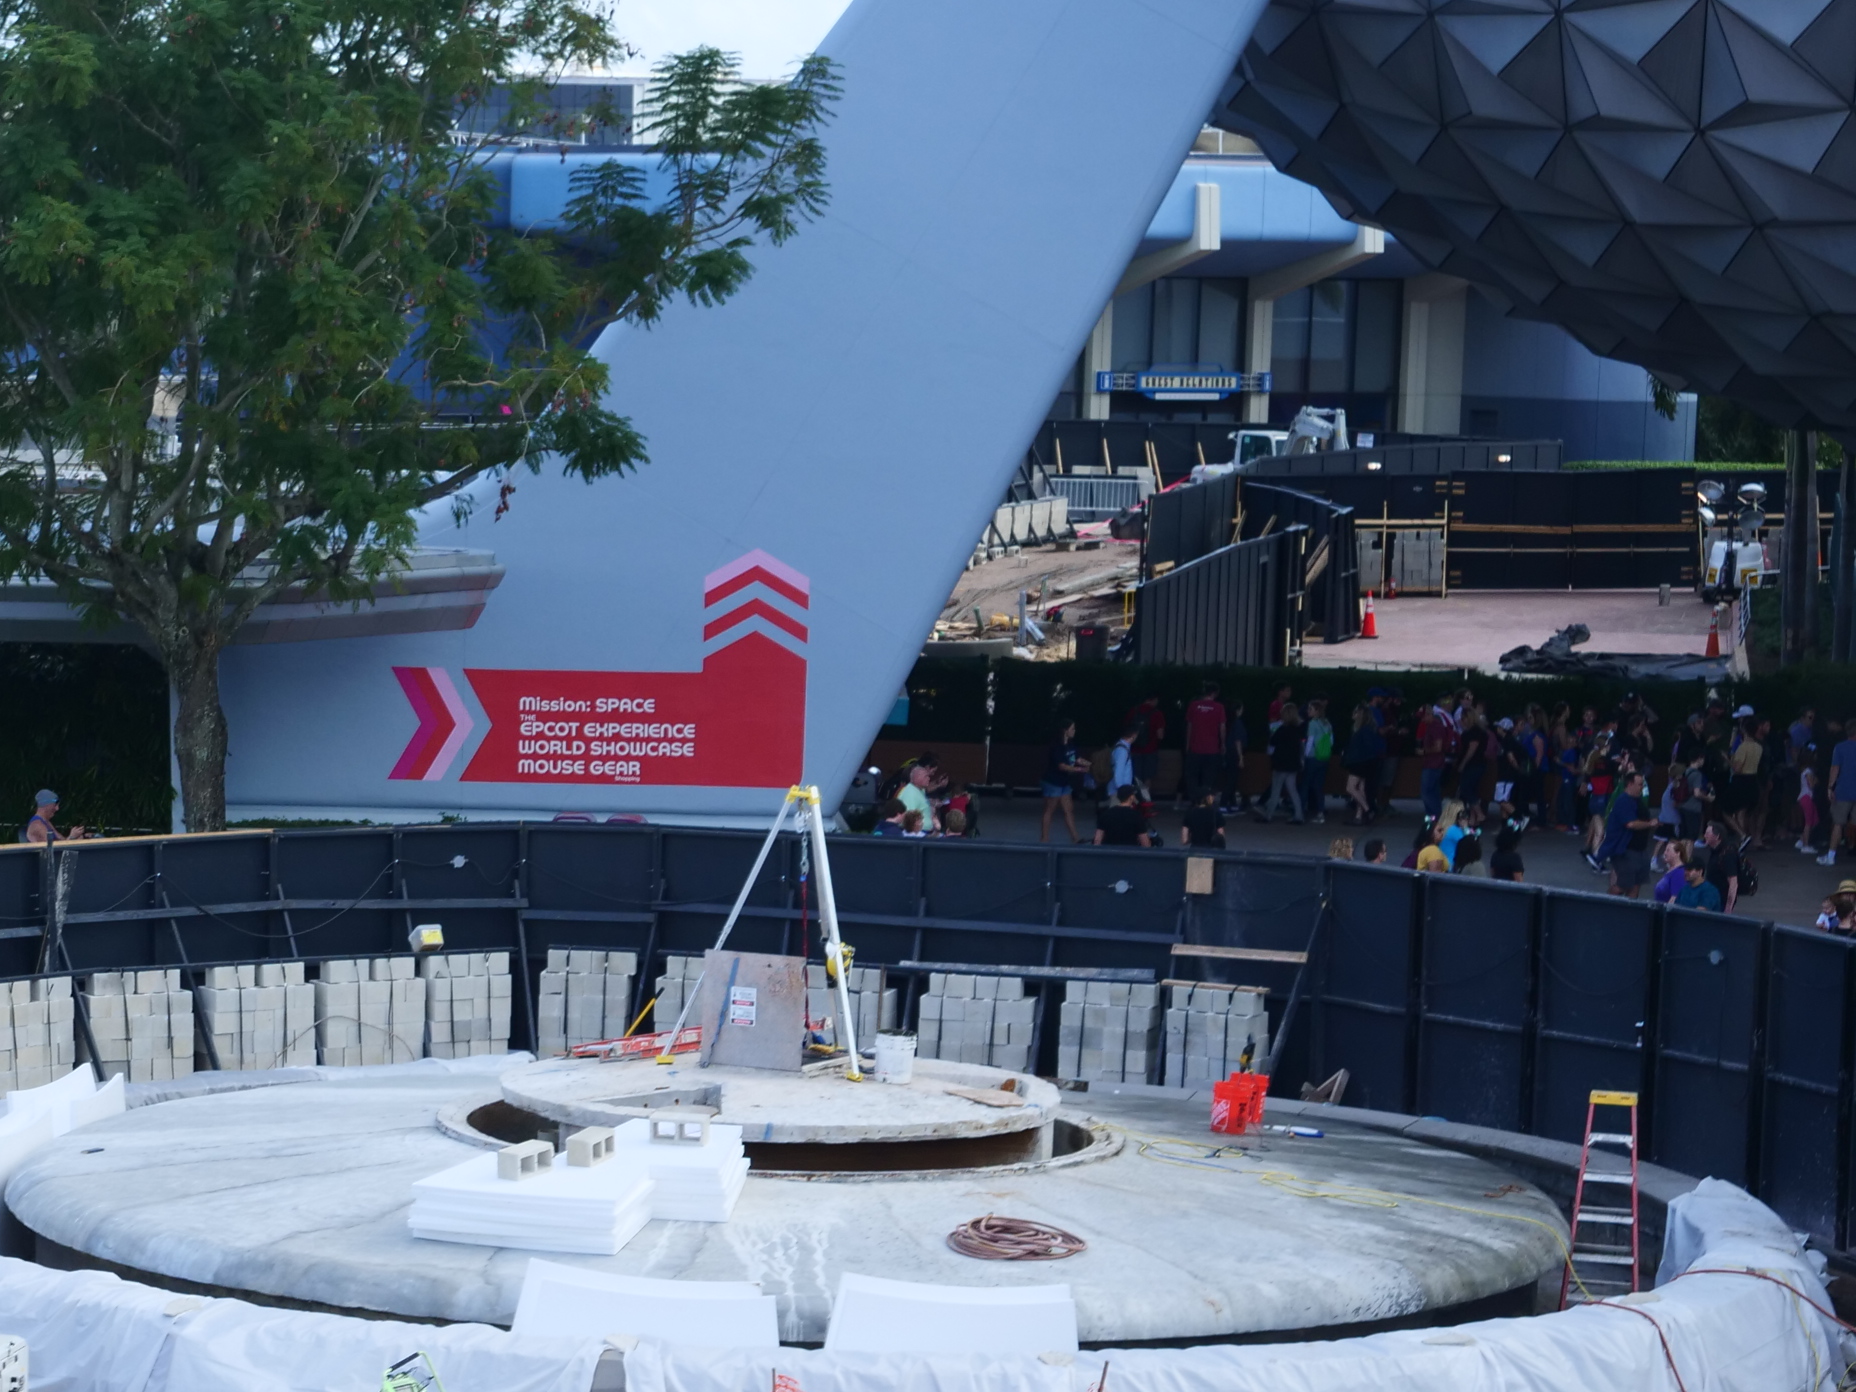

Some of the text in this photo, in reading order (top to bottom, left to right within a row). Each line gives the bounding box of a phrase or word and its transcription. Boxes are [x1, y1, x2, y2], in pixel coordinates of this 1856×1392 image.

[519, 696, 655, 713] Mission: SPACE
[520, 714, 536, 722] THE
[520, 722, 696, 738] EPCOT EXPERIENCE
[518, 739, 695, 757] WORLD SHOWCASE
[517, 759, 641, 776] MOUSE GEAR
